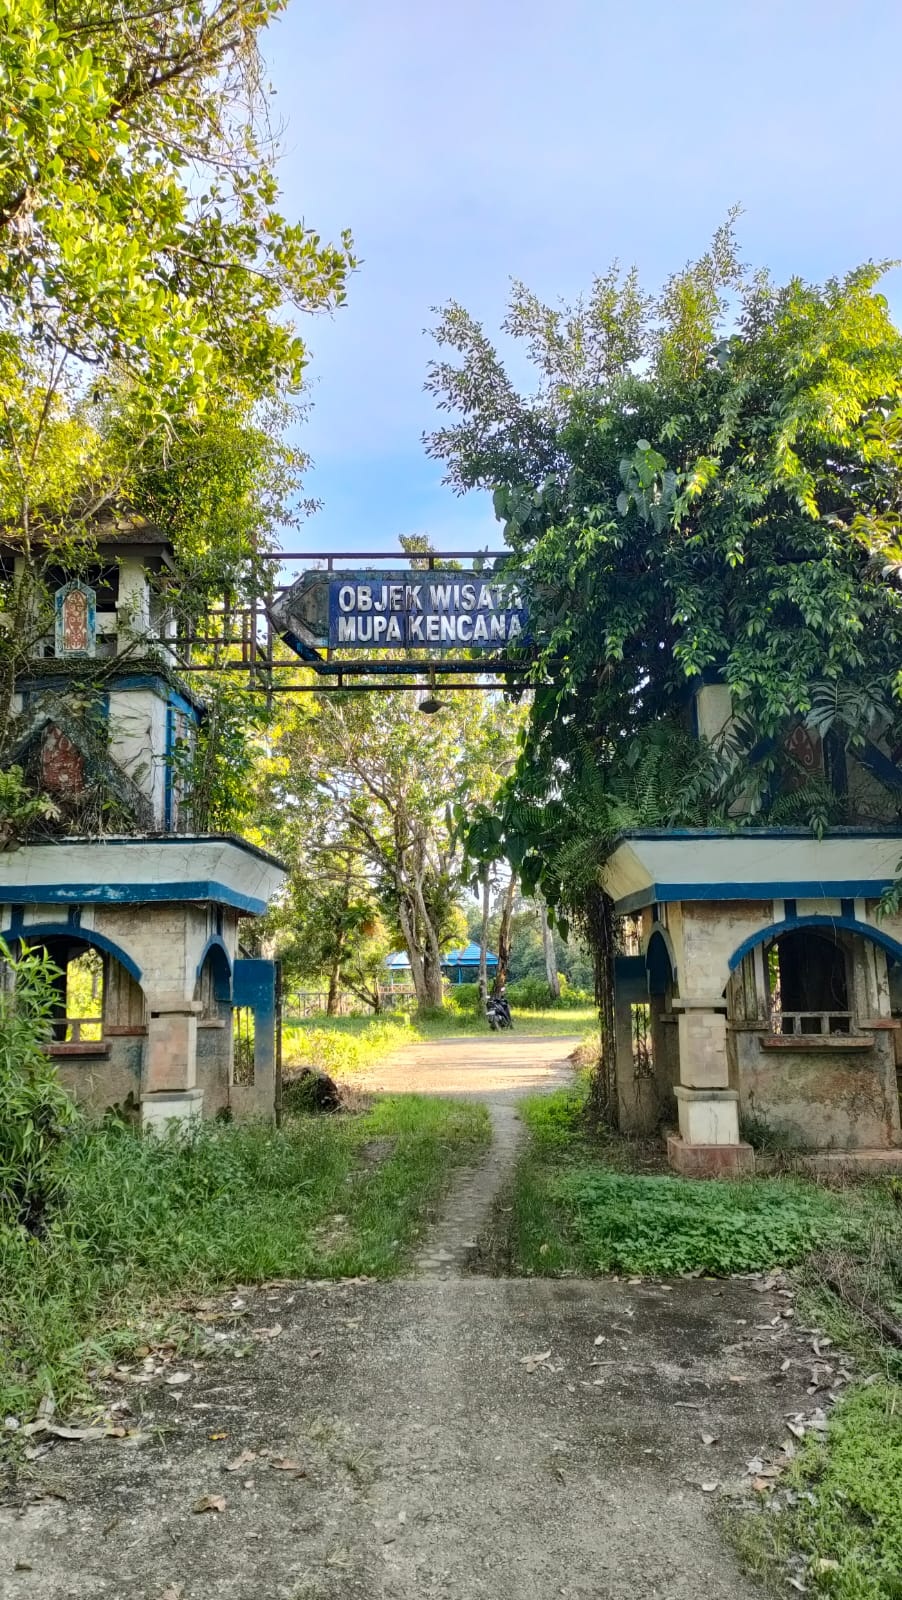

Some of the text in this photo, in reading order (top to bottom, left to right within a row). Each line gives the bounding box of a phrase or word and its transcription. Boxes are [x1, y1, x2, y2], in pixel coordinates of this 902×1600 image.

[338, 584, 523, 612] OBJEK WISATA
[338, 614, 522, 642] MUPA KENCANA
